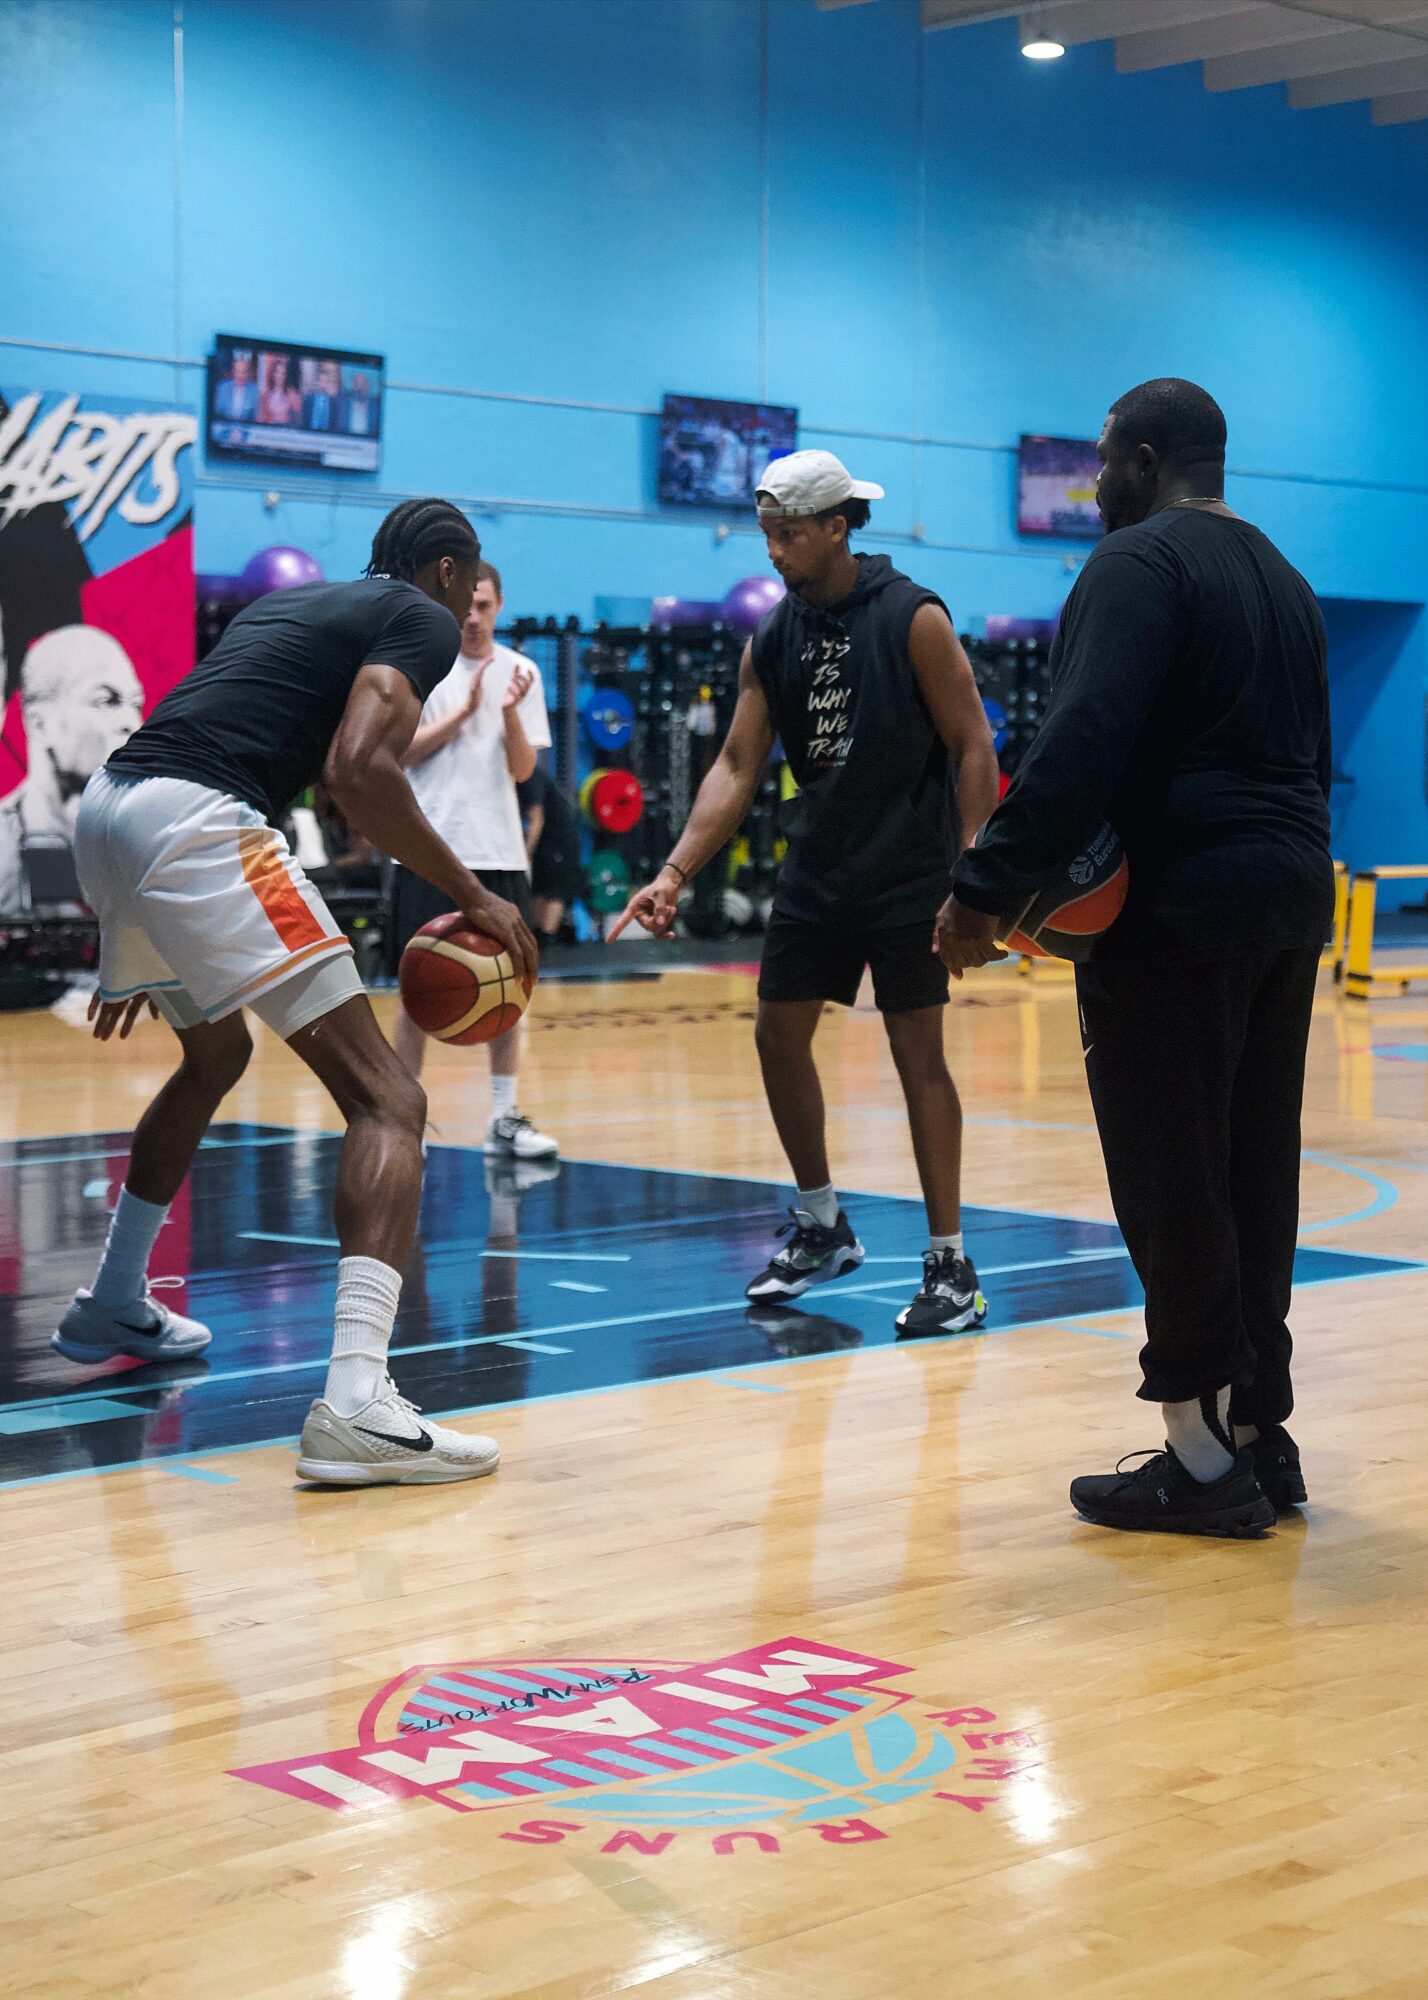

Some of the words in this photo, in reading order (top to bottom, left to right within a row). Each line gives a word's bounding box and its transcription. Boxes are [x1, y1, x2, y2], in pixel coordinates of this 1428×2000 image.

[812, 663, 841, 687] IS
[808, 688, 851, 711] WHY
[816, 713, 848, 735] WE
[287, 1649, 880, 1805] MIAMI
[923, 1706, 1038, 1812] REMY
[498, 1818, 891, 1857] RUNS
